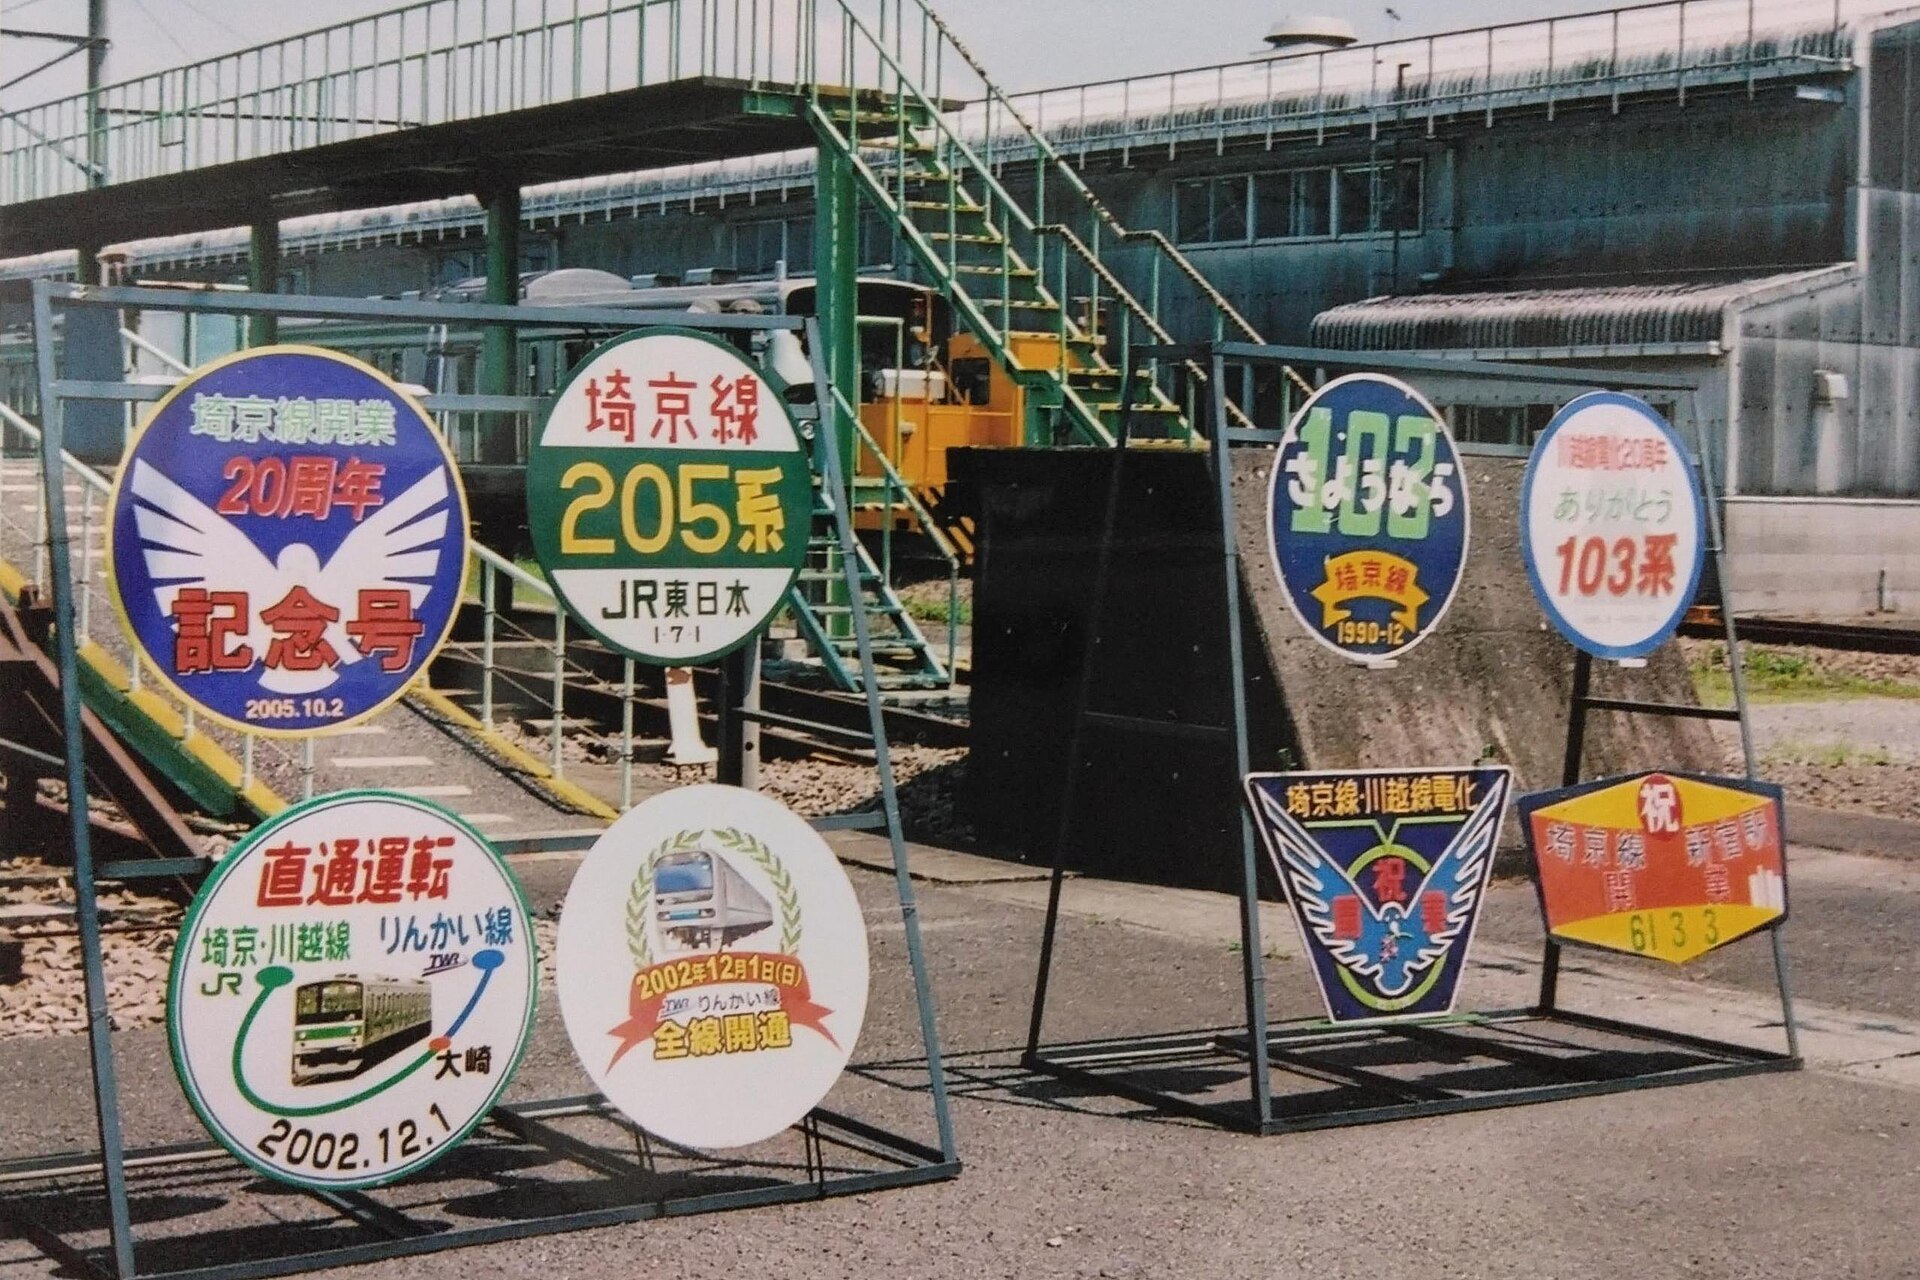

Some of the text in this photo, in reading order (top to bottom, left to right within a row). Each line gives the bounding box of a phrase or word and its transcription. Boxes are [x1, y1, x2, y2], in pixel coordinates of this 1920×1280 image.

[190, 393, 397, 446] 埼京線開業
[585, 370, 758, 444] 埼京線
[218, 456, 386, 521] 20周年
[1290, 407, 1437, 539] 103
[560, 462, 785, 554] 205系
[1553, 487, 1673, 523] ありがとう
[1335, 559, 1409, 595] 埼京線
[1557, 534, 1678, 597] 103系
[602, 580, 750, 618] JR東日本
[171, 585, 425, 675] 記念号
[246, 700, 344, 719] 2005.10.2
[1286, 774, 1480, 818] 埼京線・川越線電化
[1640, 781, 1680, 833] 祝
[257, 836, 456, 907] 直通運転
[201, 920, 351, 966] 埼京・川越線
[380, 906, 515, 954] りんかい線
[201, 973, 242, 996] JR
[636, 954, 803, 1000] 2002年12月1日(日)
[653, 1010, 793, 1060] 全線開通
[435, 1047, 492, 1080] 大崎
[257, 1102, 451, 1170] 2002.12.1
